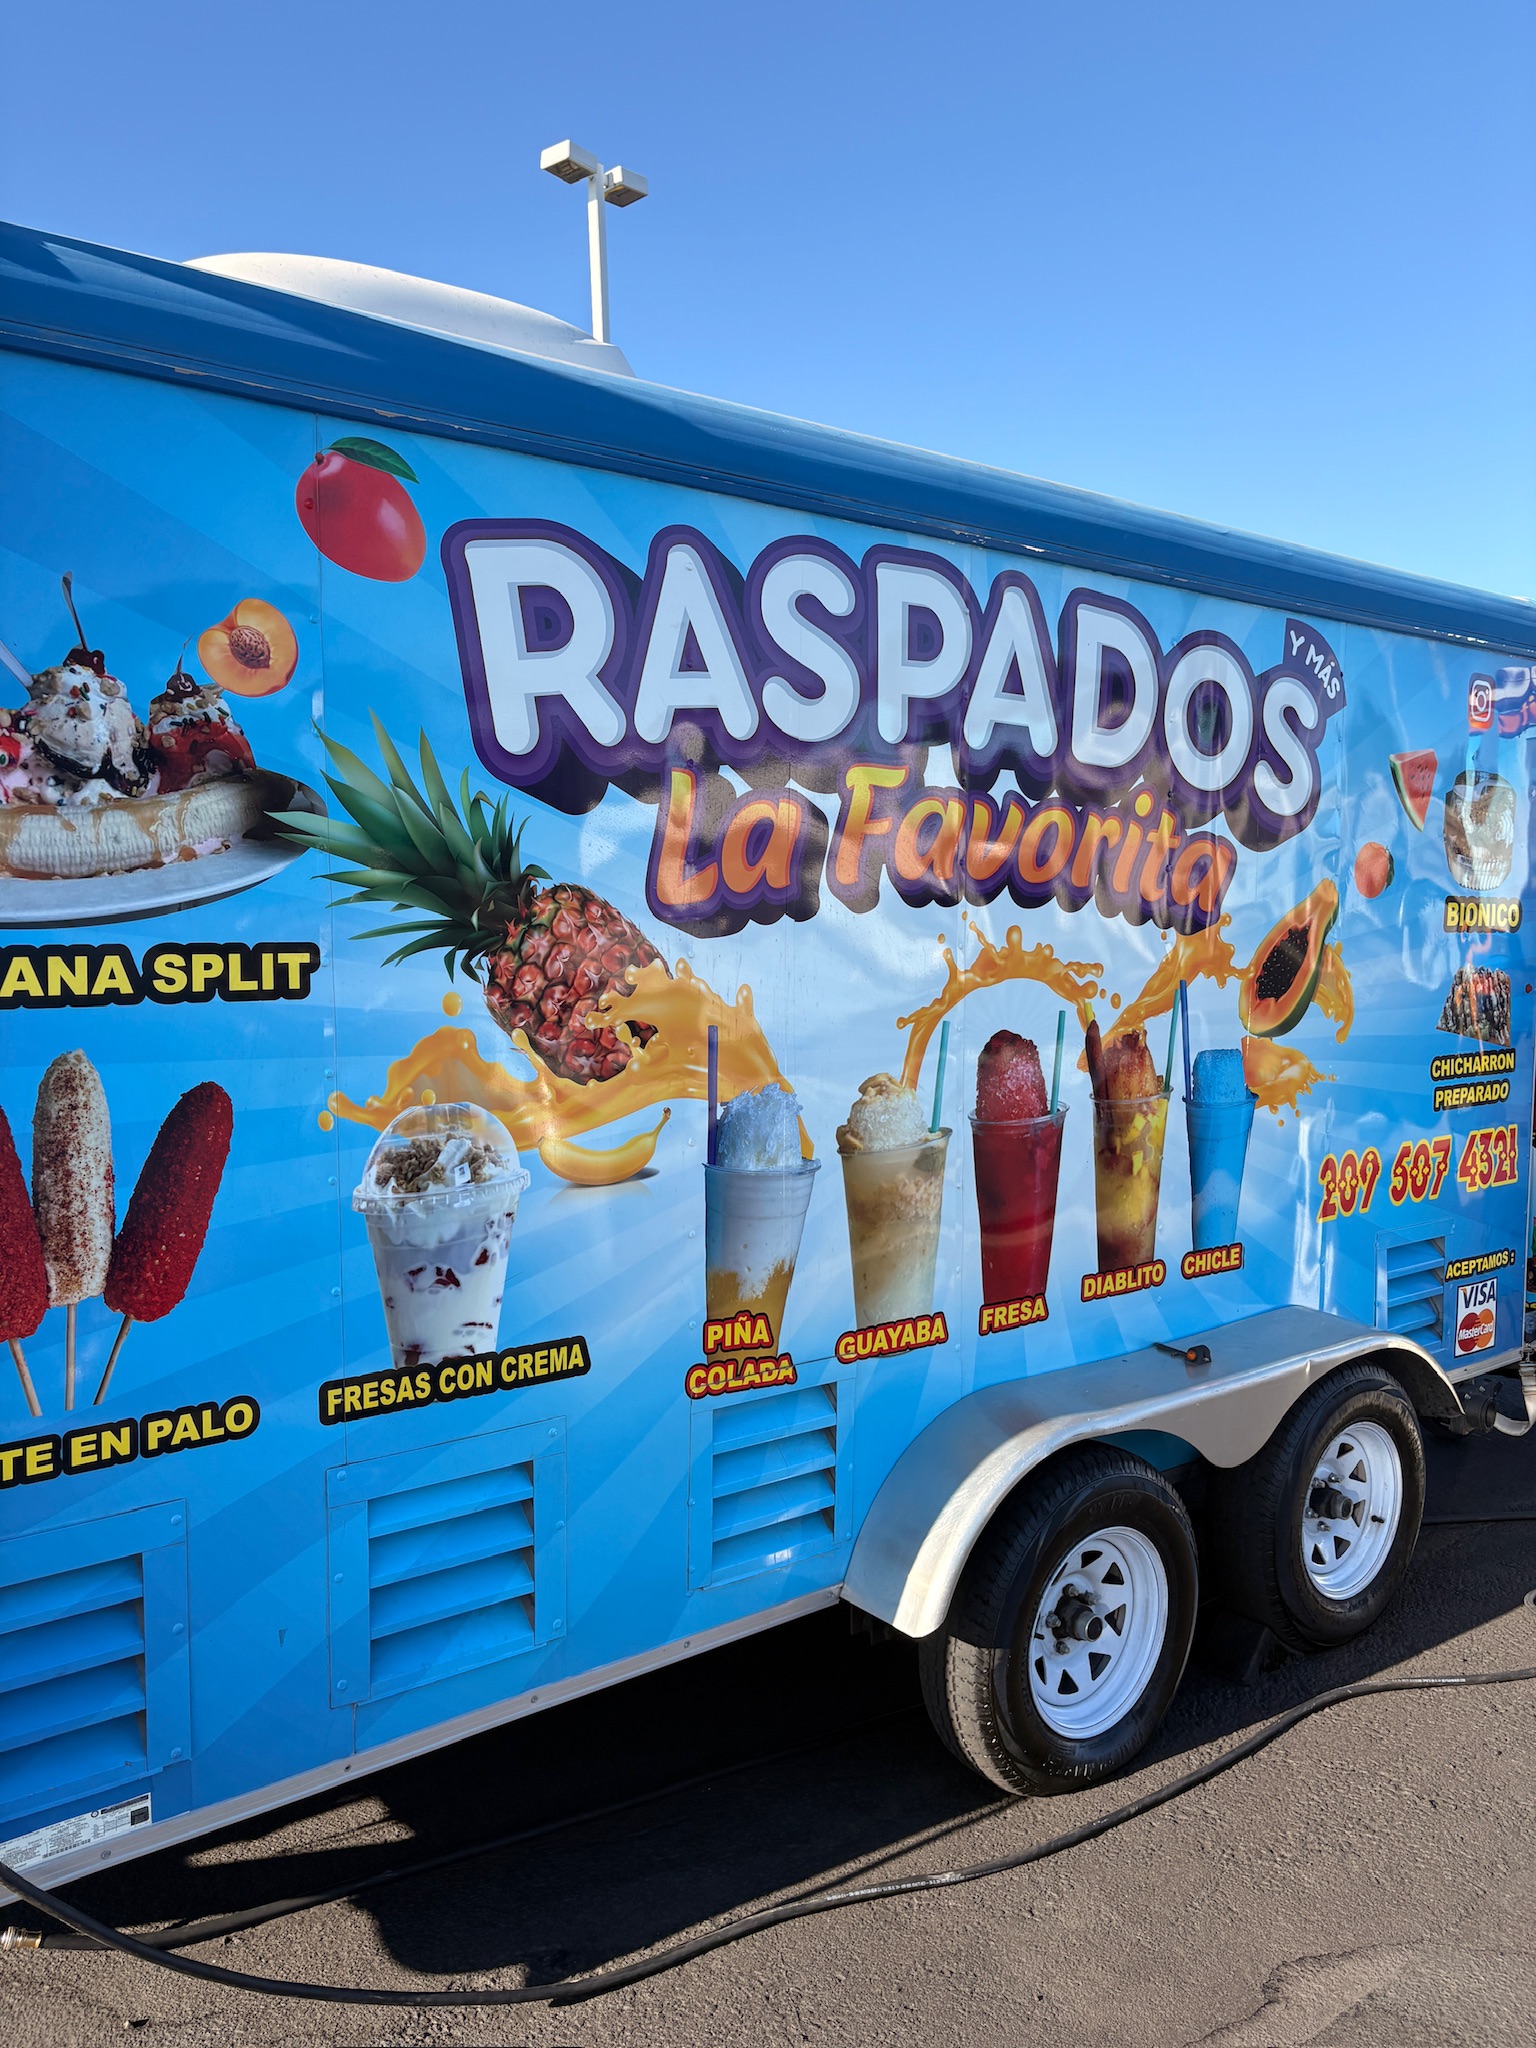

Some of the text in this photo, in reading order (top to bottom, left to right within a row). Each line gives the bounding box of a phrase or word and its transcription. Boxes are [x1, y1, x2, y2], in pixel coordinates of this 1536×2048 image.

[464, 538, 1319, 818] RASPADOS
[1290, 630, 1340, 699] Y MÁS
[656, 764, 1231, 913] La Favorita
[1447, 901, 1519, 928] BIONICO
[0, 953, 310, 997] ANA SPLIT
[1432, 1053, 1514, 1077] CHICHARRON
[1435, 1082, 1509, 1108] PREPARADO
[1316, 1124, 1518, 1223] 209 507 4321
[1184, 1248, 1240, 1275] CHICLE
[1084, 1262, 1164, 1298] DIABLITO
[1460, 1281, 1496, 1308] VISA
[982, 1298, 1045, 1331] FRESA
[1458, 1321, 1494, 1341] MasterCard
[707, 1316, 769, 1349] PIÑA
[839, 1316, 945, 1357] GUAYABA
[327, 1344, 584, 1415] FRESAS CON CREMA
[690, 1360, 793, 1393] COLADA
[71, 1430, 130, 1467] EN
[147, 1402, 253, 1448] PALO
